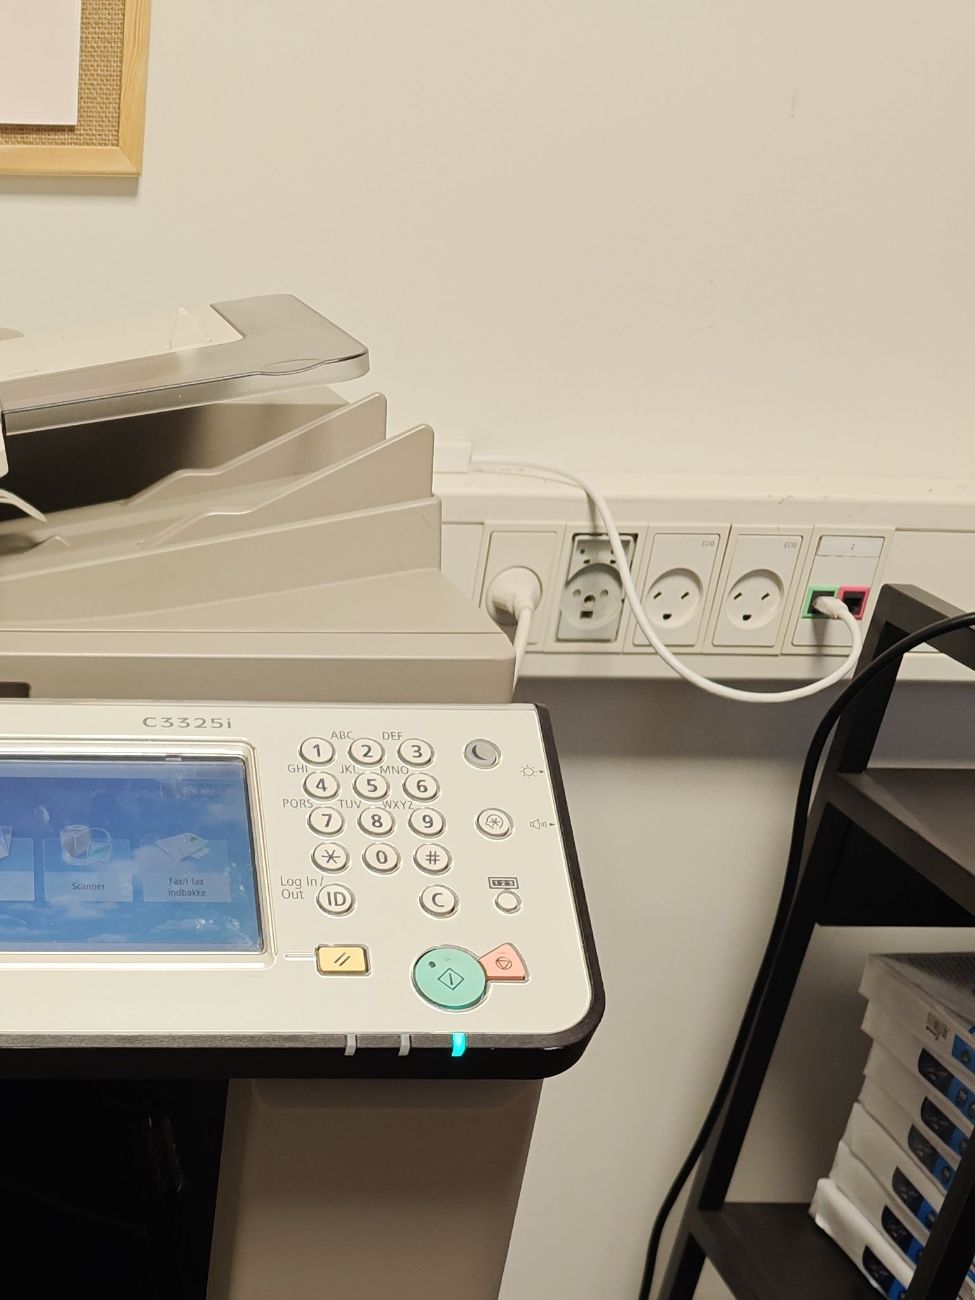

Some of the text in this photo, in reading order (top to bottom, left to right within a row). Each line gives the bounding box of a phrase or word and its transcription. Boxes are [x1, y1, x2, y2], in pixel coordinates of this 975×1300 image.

[142, 716, 232, 730] C3325i
[330, 730, 355, 740] ABC
[382, 731, 404, 741] DEF
[312, 744, 322, 758] 1
[361, 744, 374, 758] 2
[410, 744, 423, 758] 3
[287, 763, 308, 774] GHI
[339, 764, 358, 774] JKL
[379, 765, 410, 775] MNO
[315, 778, 328, 792] 4
[366, 778, 378, 793] 5
[416, 779, 428, 793] 6
[282, 798, 314, 809] PQRS
[337, 799, 362, 809] TUV
[381, 800, 414, 810] WXYZ
[321, 813, 333, 828] 7
[370, 813, 383, 828] 8
[422, 814, 434, 829] 9
[375, 850, 388, 864] 0
[425, 850, 440, 865] #
[71, 881, 106, 891] Scanner
[280, 875, 303, 889] Log
[168, 887, 207, 897] indbakke
[281, 889, 304, 900] Out
[326, 891, 347, 907] ID
[431, 892, 445, 908] C
